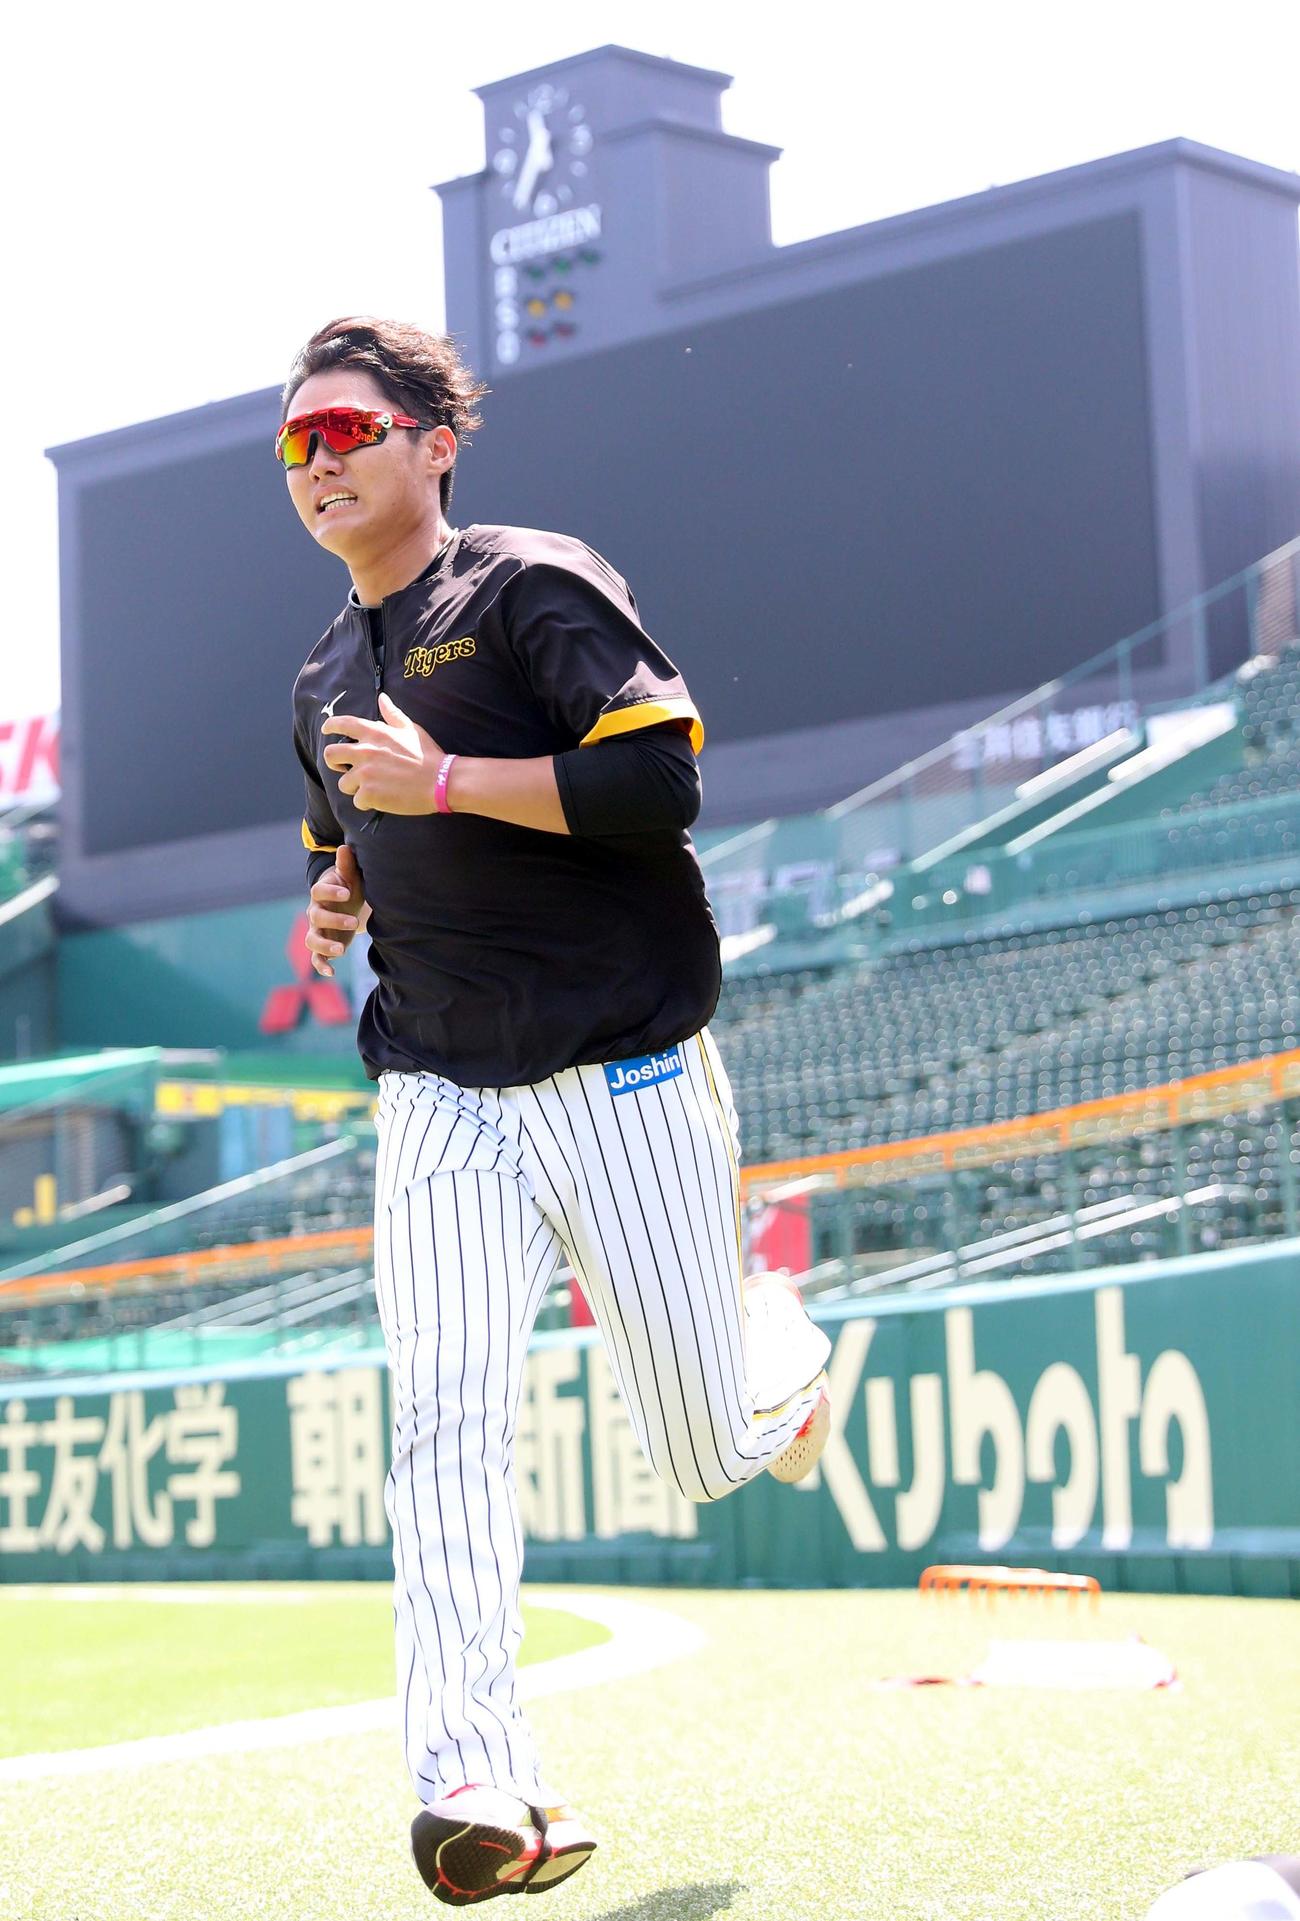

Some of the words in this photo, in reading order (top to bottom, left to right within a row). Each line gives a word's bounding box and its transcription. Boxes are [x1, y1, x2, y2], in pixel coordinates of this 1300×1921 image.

[403, 637, 476, 678] Tigers
[610, 1053, 681, 1089] Joshin
[287, 1346, 701, 1549] 朝新聞
[796, 1286, 1215, 1553] Kubota
